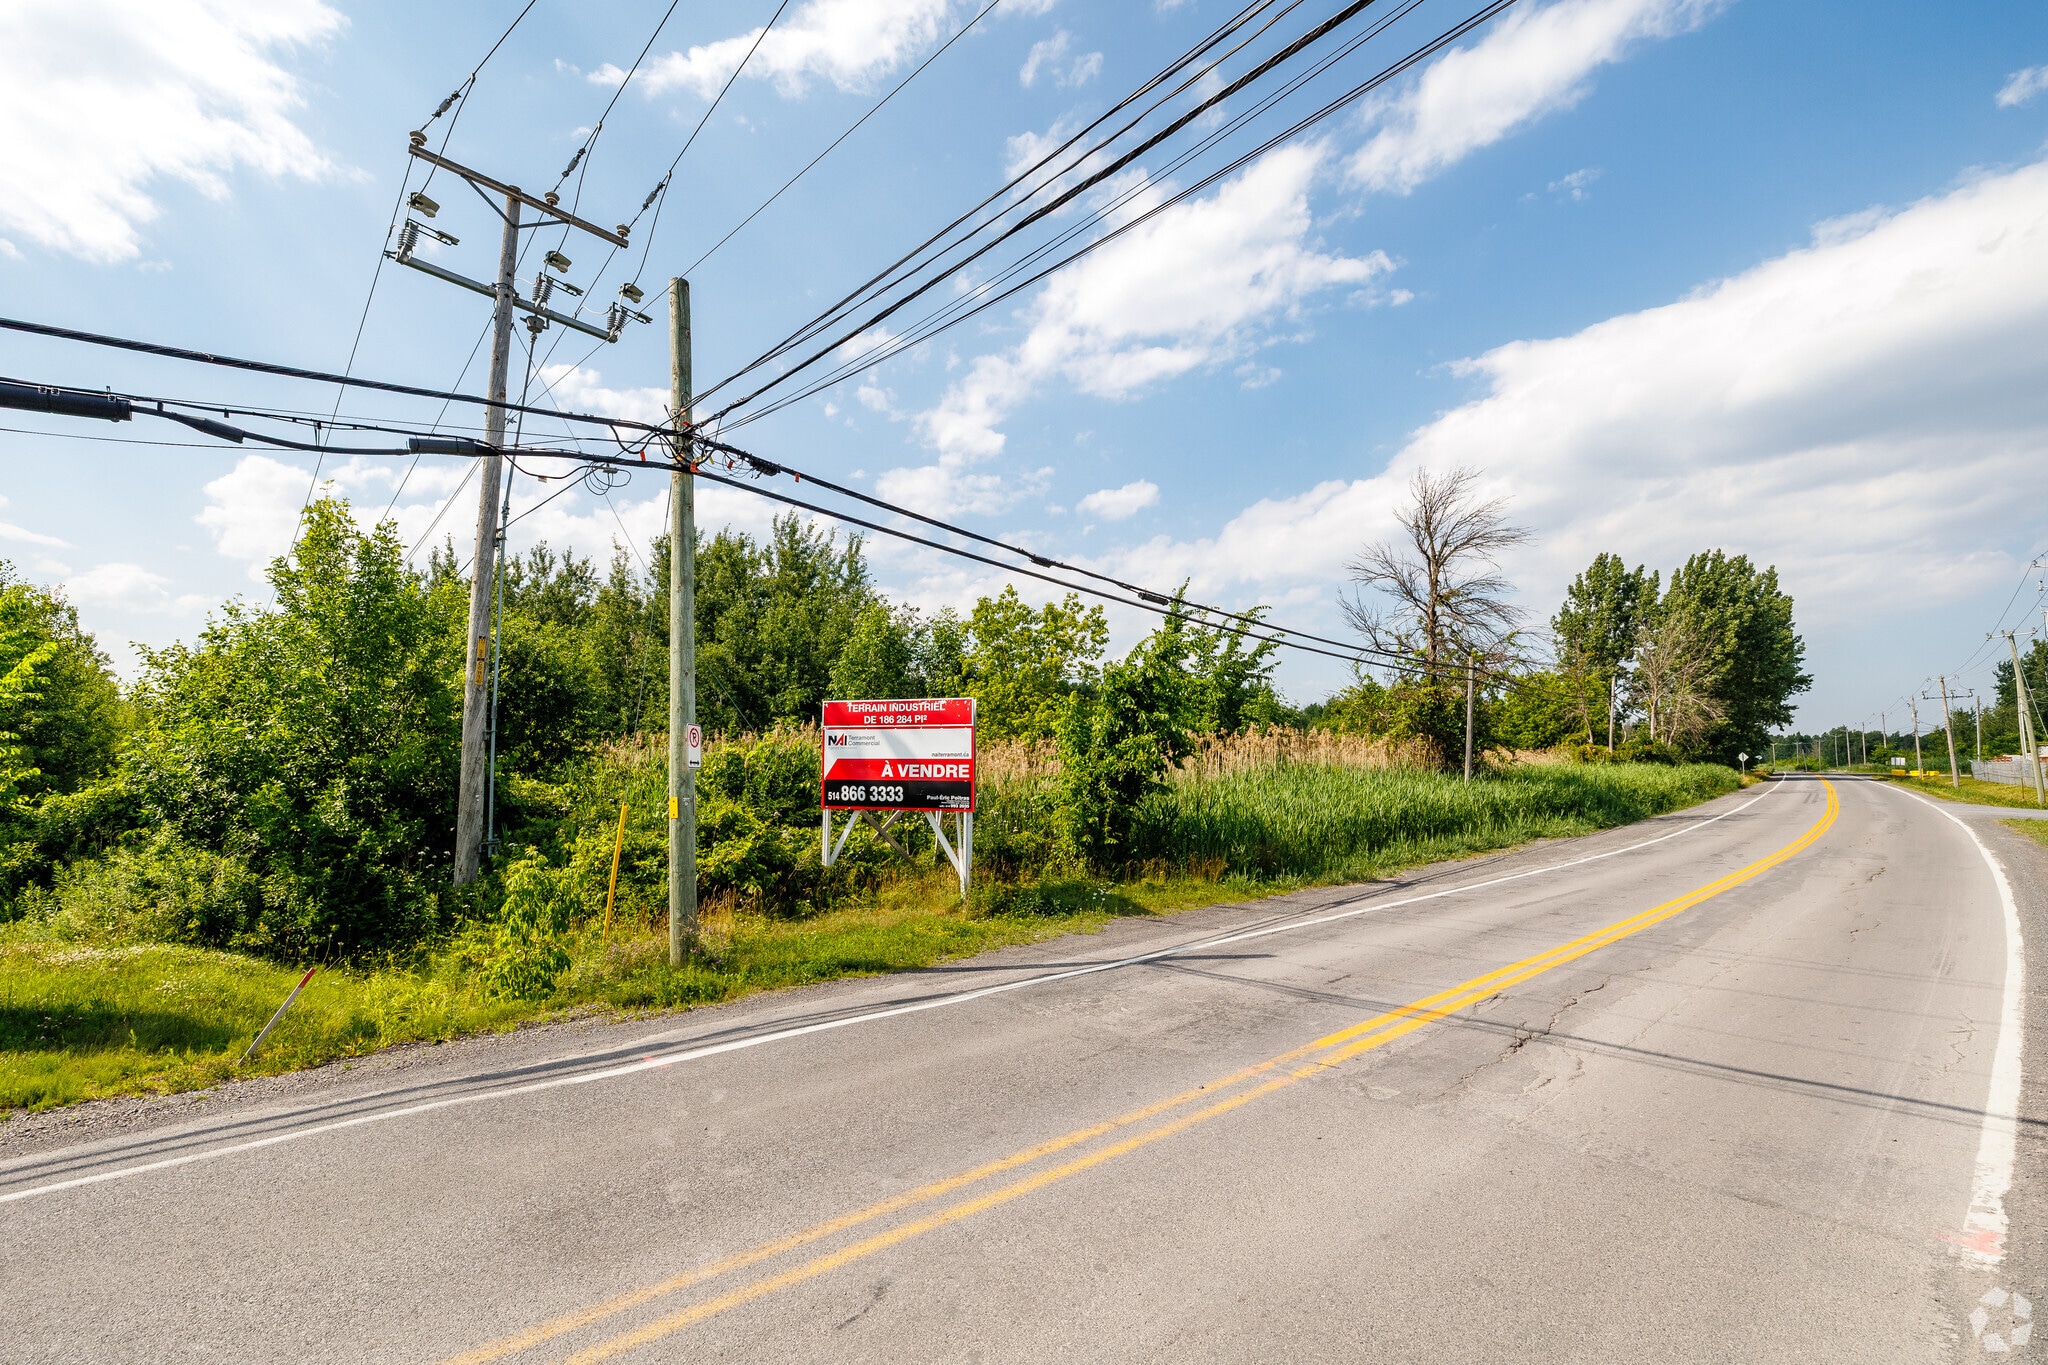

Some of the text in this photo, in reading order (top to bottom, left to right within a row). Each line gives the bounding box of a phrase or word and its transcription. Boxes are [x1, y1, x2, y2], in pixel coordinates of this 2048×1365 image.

[847, 702, 946, 712] TERRAIN INDUSTRIEL
[864, 715, 877, 724] DE
[880, 715, 894, 724] 186
[896, 715, 912, 723] 284
[828, 733, 847, 746] NAI
[881, 760, 970, 777] À VENDRE
[827, 785, 904, 802] 514 866 3333
